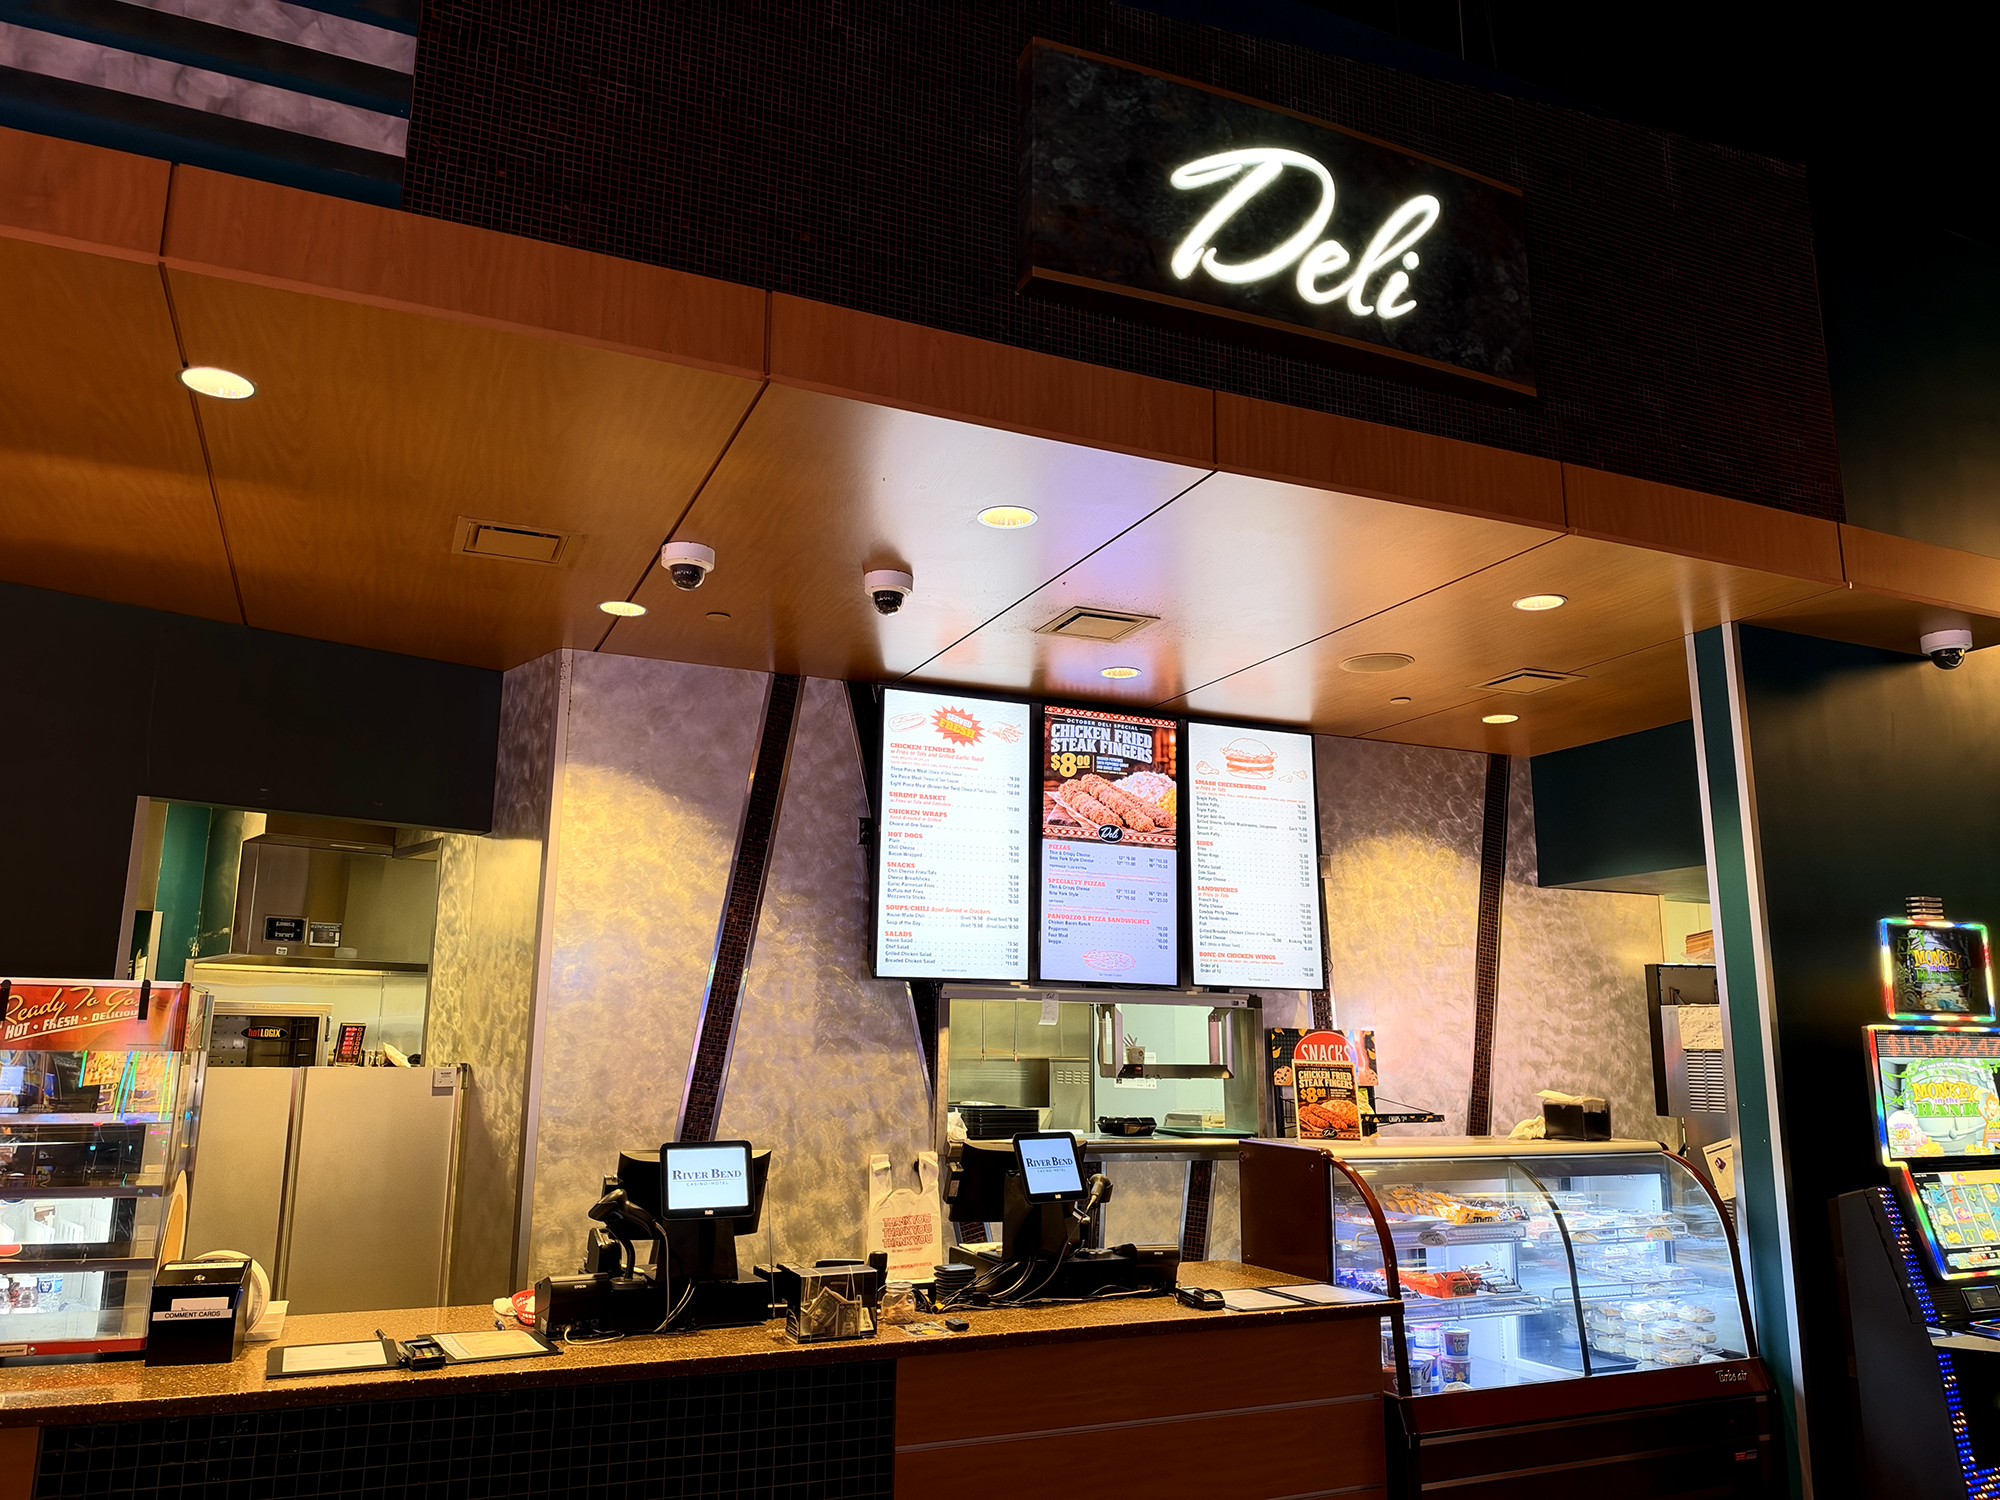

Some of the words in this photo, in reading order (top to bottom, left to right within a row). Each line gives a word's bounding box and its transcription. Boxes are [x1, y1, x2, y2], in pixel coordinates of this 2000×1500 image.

[1170, 146, 1441, 320] Deli
[1052, 723, 1110, 741] CHICKEN
[1114, 729, 1152, 749] FRIED
[1051, 738, 1097, 753] STEAK
[1100, 740, 1152, 764] FINGERS
[1218, 782, 1266, 790] CHEESEBURGERS
[1101, 827, 1119, 838] Deli
[1108, 917, 1150, 925] SANDWICHES
[1913, 949, 1962, 969] MONKEY
[5, 987, 67, 1025] Ready
[70, 987, 100, 1010] To
[5, 1022, 30, 1040] HOT
[42, 1016, 79, 1031] FRESH
[92, 1010, 138, 1022] DELICIOU
[1301, 1044, 1351, 1061] SNACKS
[1887, 1034, 2000, 1056] $15,892.47
[1299, 1071, 1330, 1079] CHICKEN
[1331, 1071, 1352, 1080] FRIED
[1299, 1079, 1324, 1088] STEAK
[1325, 1080, 1353, 1090] FINGERS
[1912, 1081, 1978, 1102] MONKEY
[1916, 1101, 1980, 1118] BANK
[1025, 1157, 1051, 1167] RIVER
[1052, 1156, 1073, 1165] BEND
[672, 1170, 708, 1180] RIVER
[711, 1168, 742, 1178] BEND
[883, 1215, 912, 1227] THANK
[912, 1213, 931, 1224] YOU
[882, 1226, 912, 1237] THANK
[912, 1224, 932, 1235] YOU
[882, 1236, 912, 1248] THANK
[913, 1234, 933, 1245] YOU
